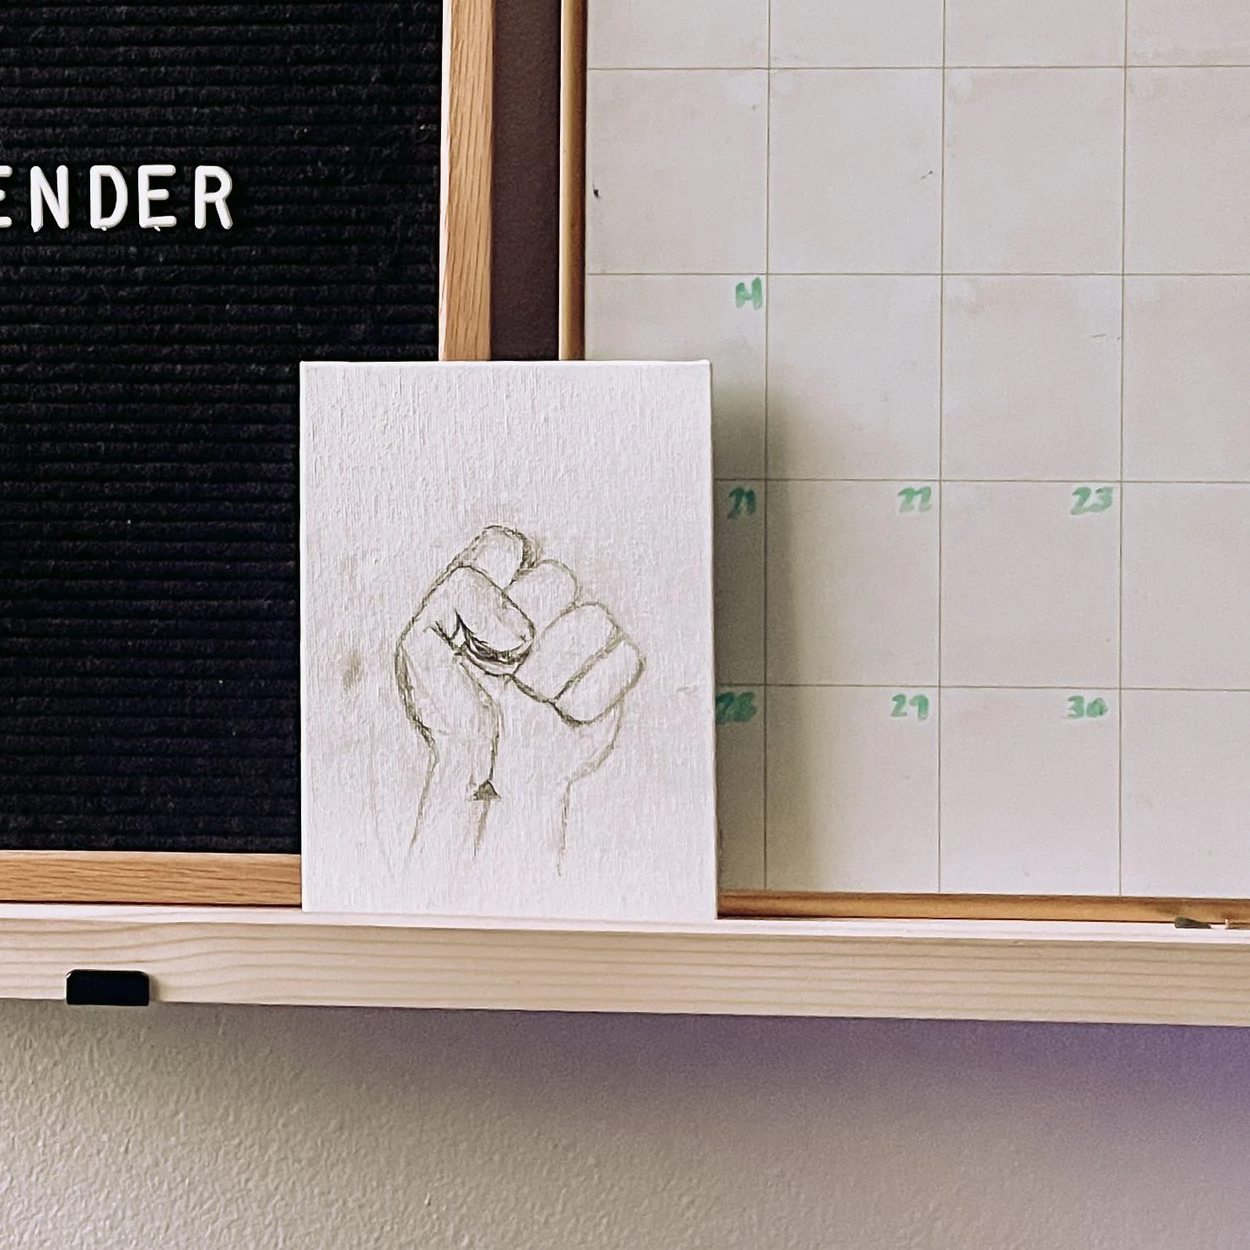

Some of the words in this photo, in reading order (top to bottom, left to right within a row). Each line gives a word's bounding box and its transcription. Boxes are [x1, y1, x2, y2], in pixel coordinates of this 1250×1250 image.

[1070, 486, 1113, 516] 23
[890, 693, 930, 722] 29
[1066, 694, 1108, 720] 30
